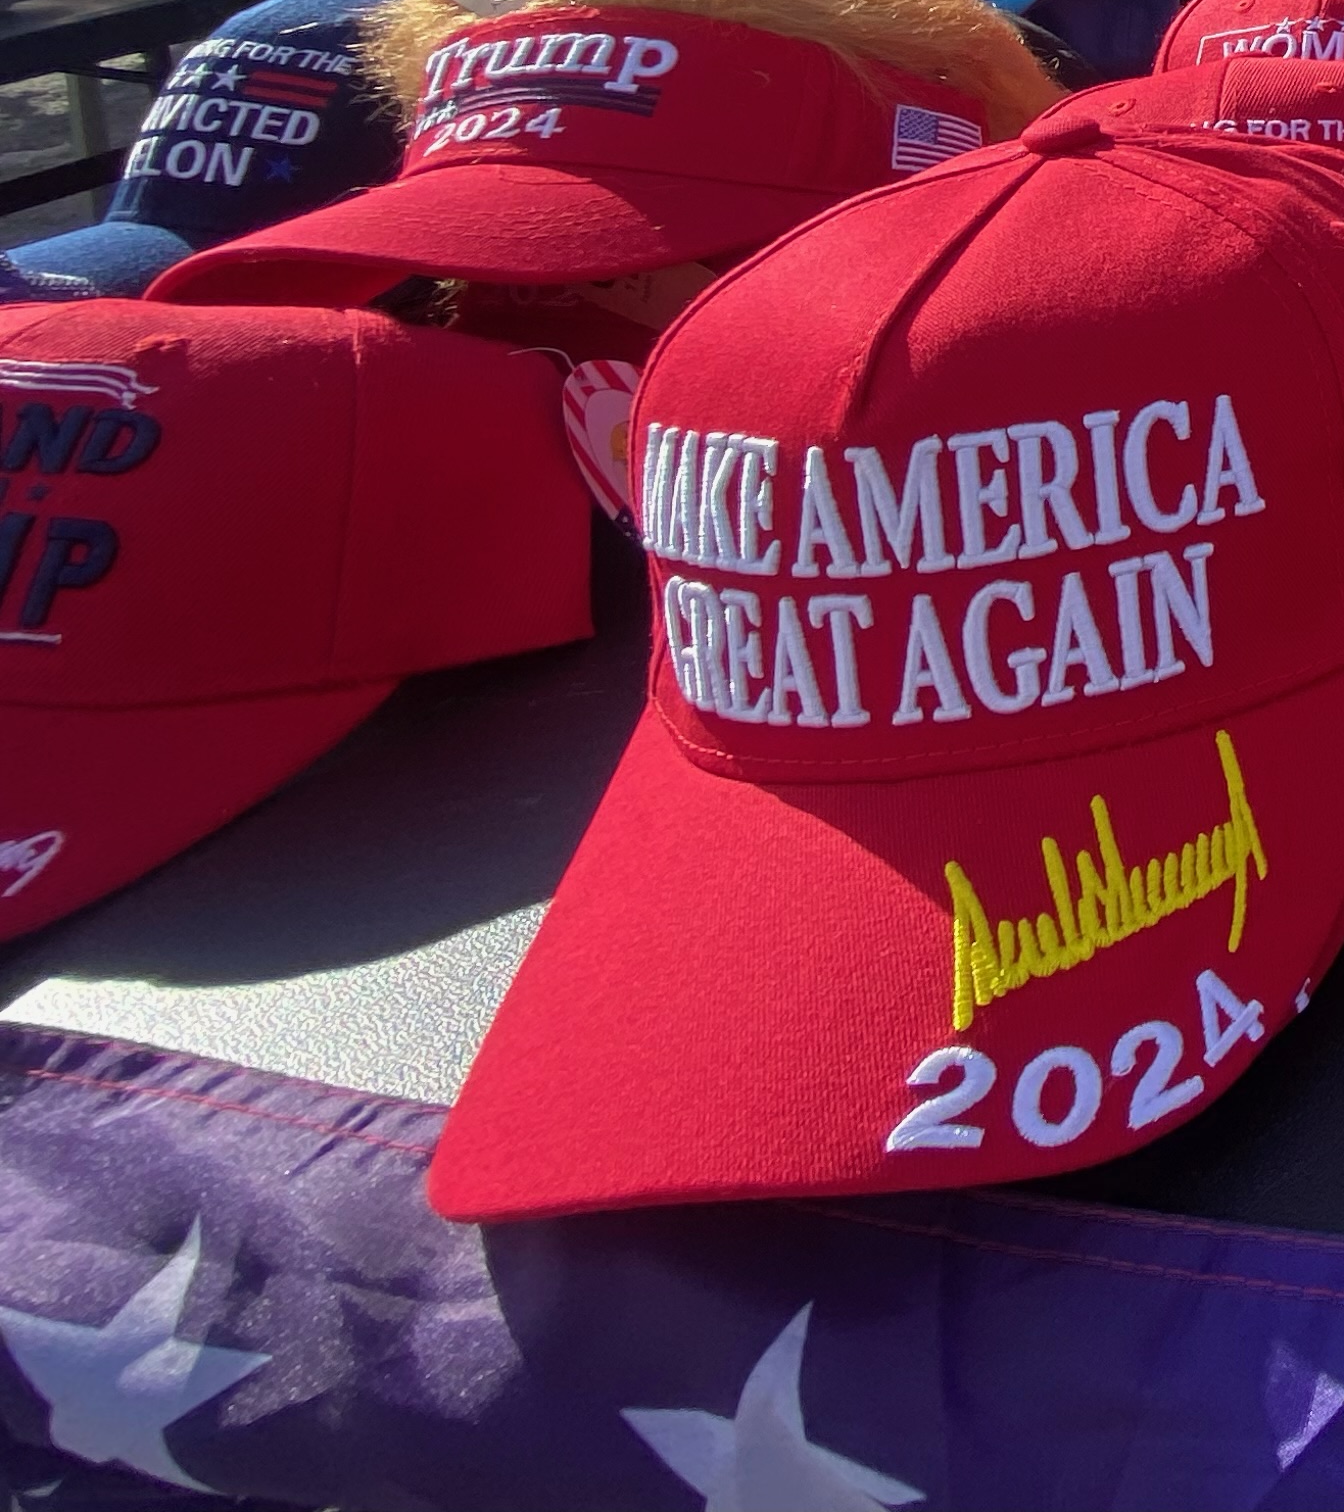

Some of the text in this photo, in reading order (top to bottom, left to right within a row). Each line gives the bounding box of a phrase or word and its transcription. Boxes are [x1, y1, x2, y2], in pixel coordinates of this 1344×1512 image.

[232, 41, 294, 66] FOR
[298, 48, 357, 76] THE
[423, 31, 679, 105] Trump
[124, 135, 255, 187] ELON
[423, 107, 565, 157] 2024
[1246, 118, 1312, 141] FOR
[642, 393, 1266, 580] MAKE AMERICA
[662, 542, 1215, 729] GREAT AGAIN
[885, 969, 1267, 1154] 2024
